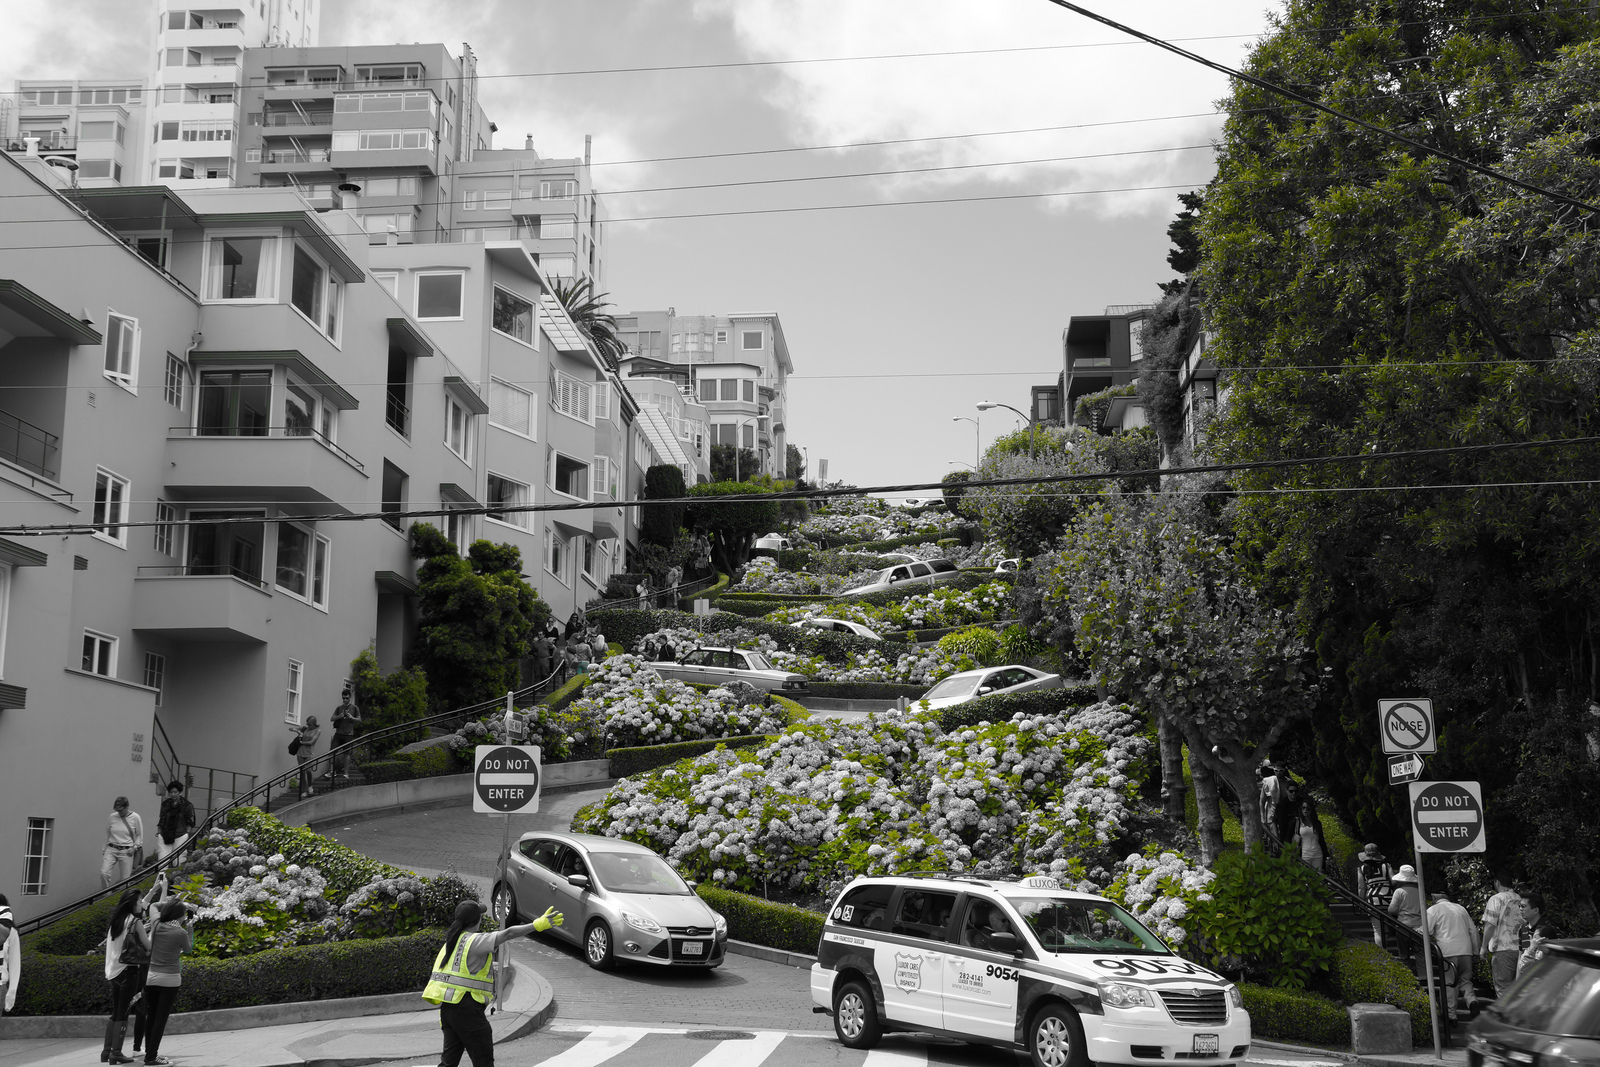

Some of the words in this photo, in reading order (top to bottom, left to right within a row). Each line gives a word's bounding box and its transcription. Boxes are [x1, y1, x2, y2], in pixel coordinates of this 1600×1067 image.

[485, 759, 501, 770] DO
[506, 759, 530, 770] NOT
[1393, 764, 1403, 775] ONE
[1403, 761, 1414, 774] WAY
[488, 788, 525, 799] ENTER
[1421, 796, 1439, 808] DO
[1444, 795, 1470, 807] NOT
[1429, 826, 1469, 838] ENTER
[1029, 879, 1060, 889] LUXOR
[898, 961, 909, 969] LUXOR
[909, 962, 919, 971] CABS
[1093, 959, 1220, 979] 9054
[959, 972, 983, 983] 282-4141
[986, 964, 1019, 982] 9054
[900, 979, 916, 988] DISPATCH
[951, 983, 992, 996] www.luxorcab.com
